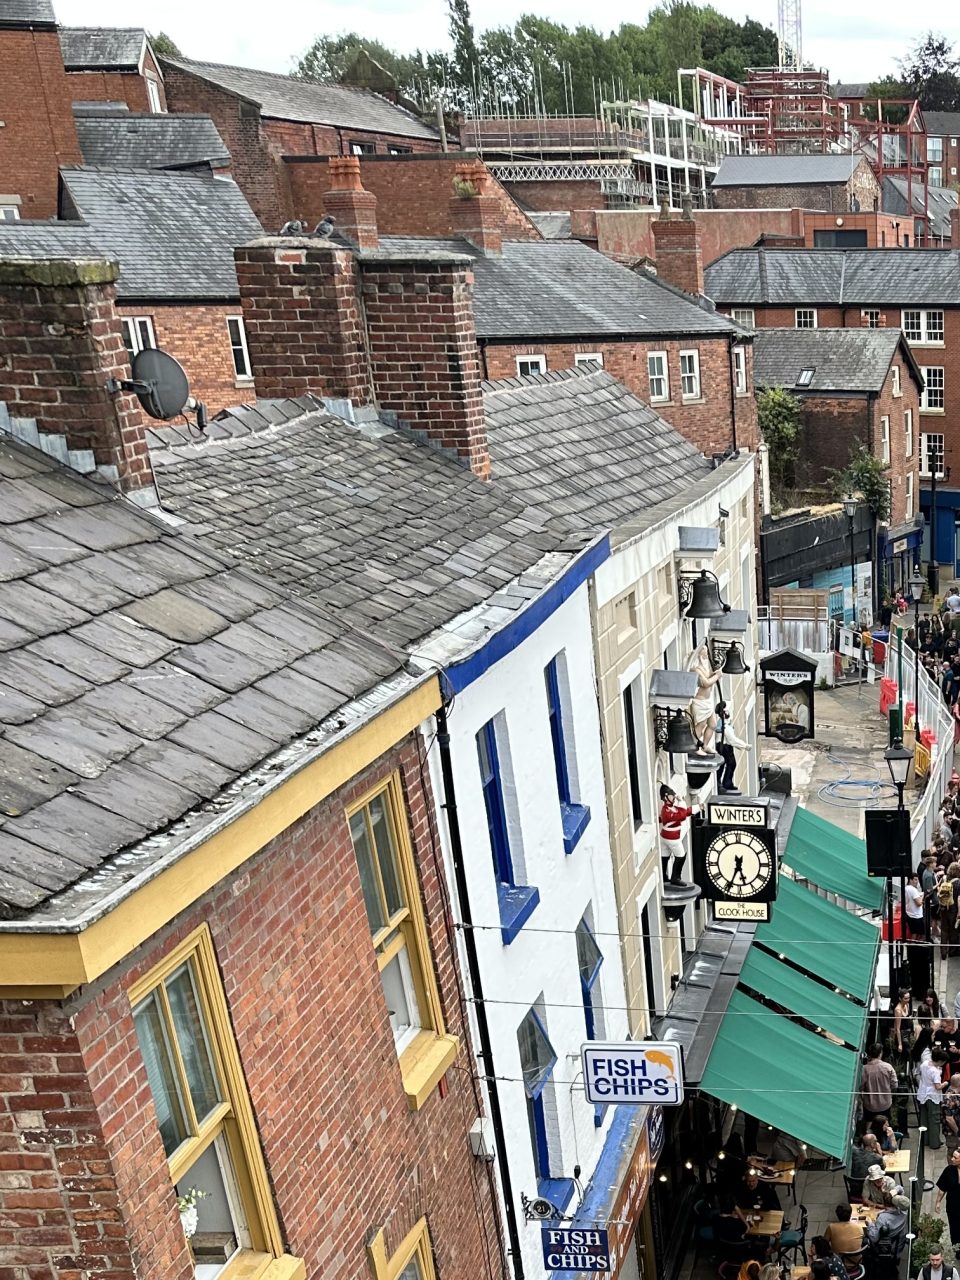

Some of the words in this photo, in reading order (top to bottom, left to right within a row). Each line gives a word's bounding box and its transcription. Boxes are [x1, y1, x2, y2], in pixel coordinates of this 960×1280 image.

[714, 808, 762, 823] WINTER'S
[718, 908, 741, 916] CLOCK
[742, 909, 765, 917] HOUSE
[592, 1058, 647, 1076] FISH
[594, 1078, 669, 1096] CHIPS
[547, 1230, 603, 1245] FISH
[563, 1245, 589, 1254] AND
[547, 1254, 608, 1269] CHIPS
